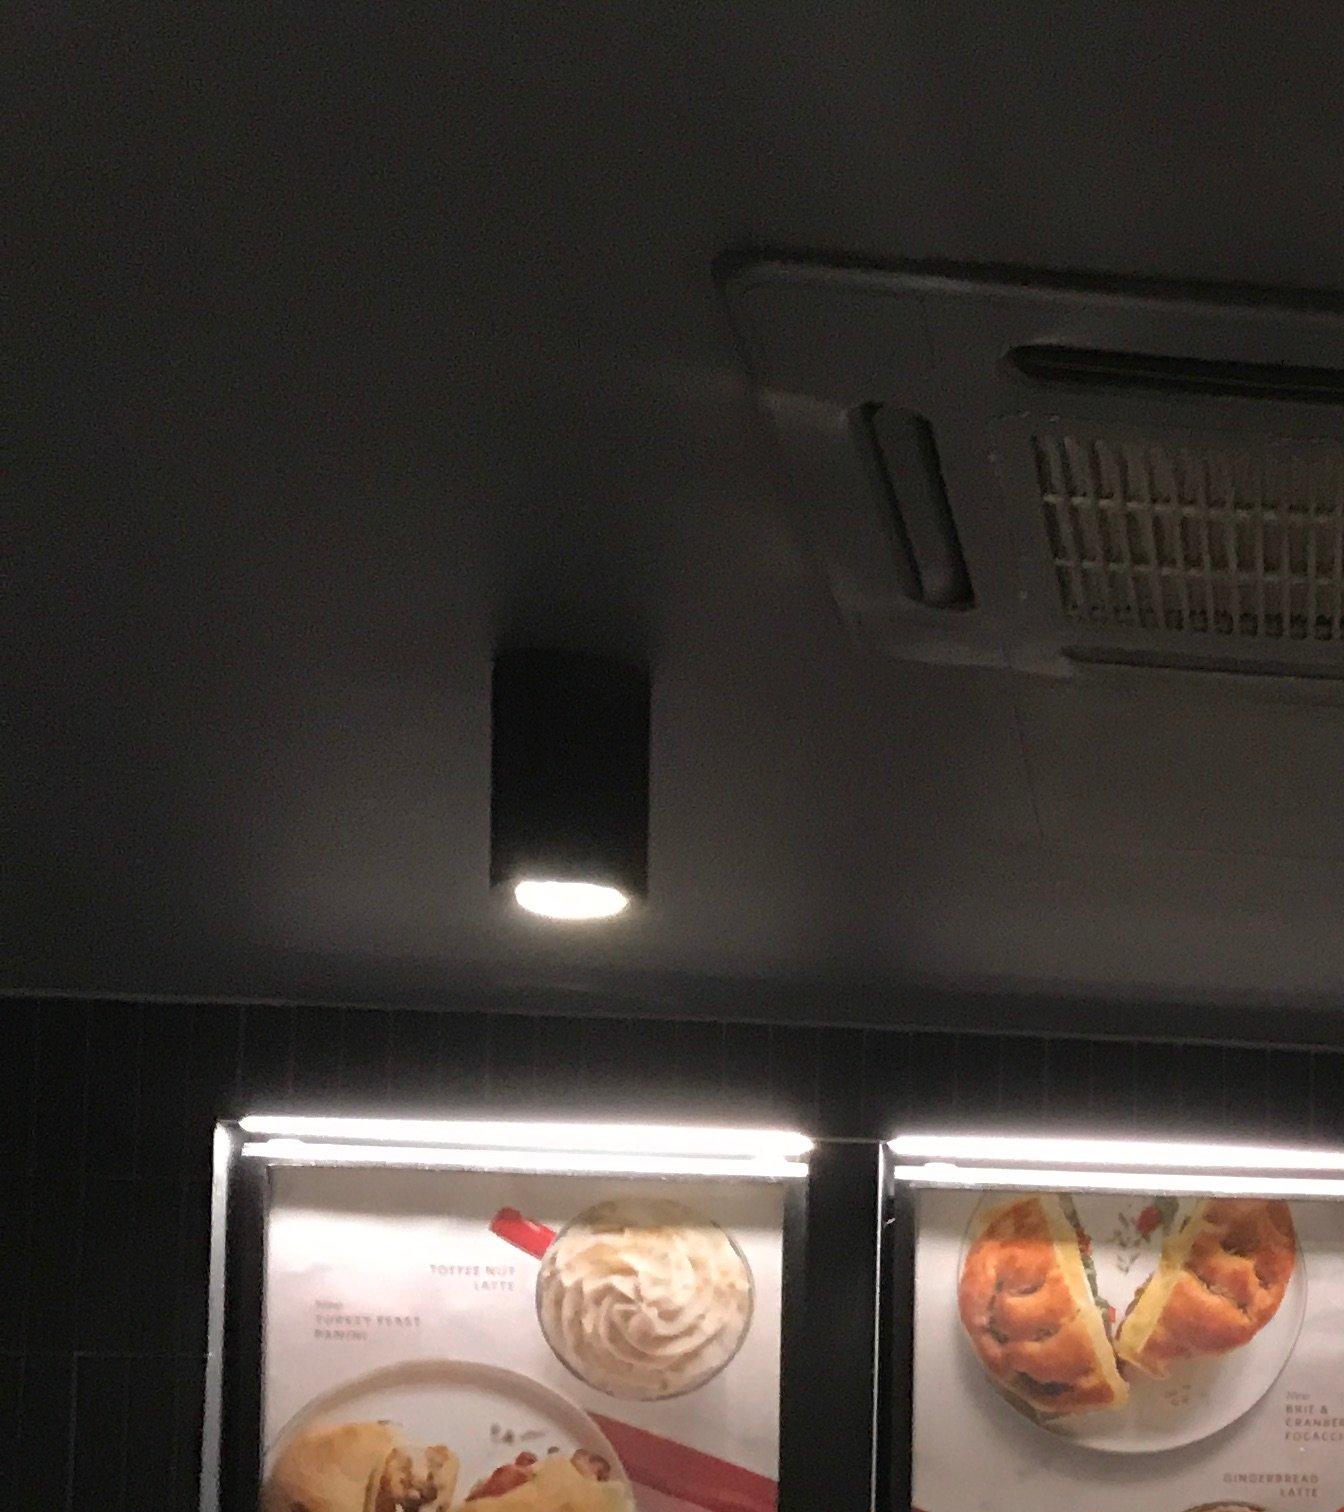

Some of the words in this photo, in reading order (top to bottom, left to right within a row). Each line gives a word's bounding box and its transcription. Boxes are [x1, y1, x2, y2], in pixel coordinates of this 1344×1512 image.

[1286, 1405, 1314, 1414] BRIE
[1320, 1405, 1328, 1414] &
[1223, 1473, 1319, 1484] GINGERBREAD
[1280, 1488, 1318, 1497] LATTE
